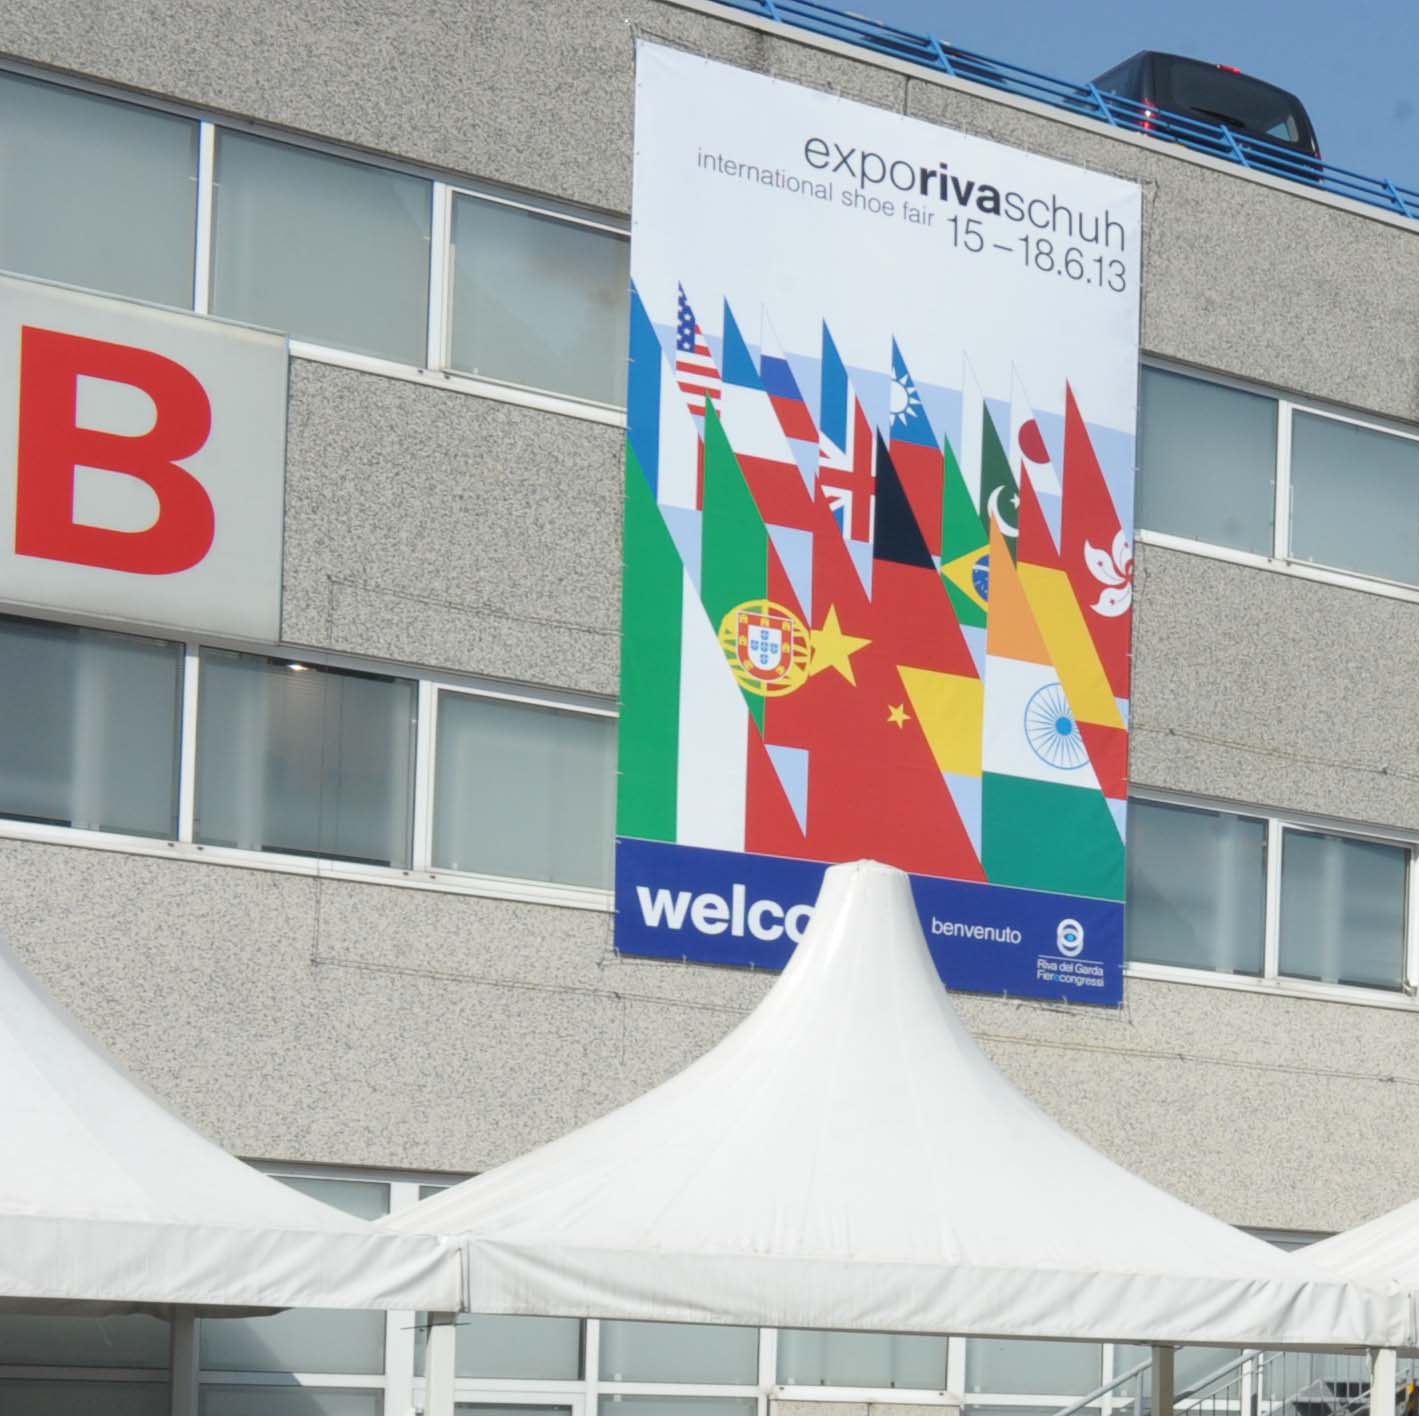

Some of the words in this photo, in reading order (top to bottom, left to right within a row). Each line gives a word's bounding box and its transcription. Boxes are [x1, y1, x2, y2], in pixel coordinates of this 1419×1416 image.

[697, 147, 833, 202] international
[841, 187, 895, 217] shoe
[902, 200, 935, 227] fair
[804, 136, 1126, 252] exporivaschuh
[15, 325, 215, 575] B
[636, 883, 814, 944] welco
[931, 917, 1022, 944] benvenuto
[1036, 958, 1057, 971] Riva
[1059, 961, 1074, 972] del
[1075, 963, 1104, 976] Garda
